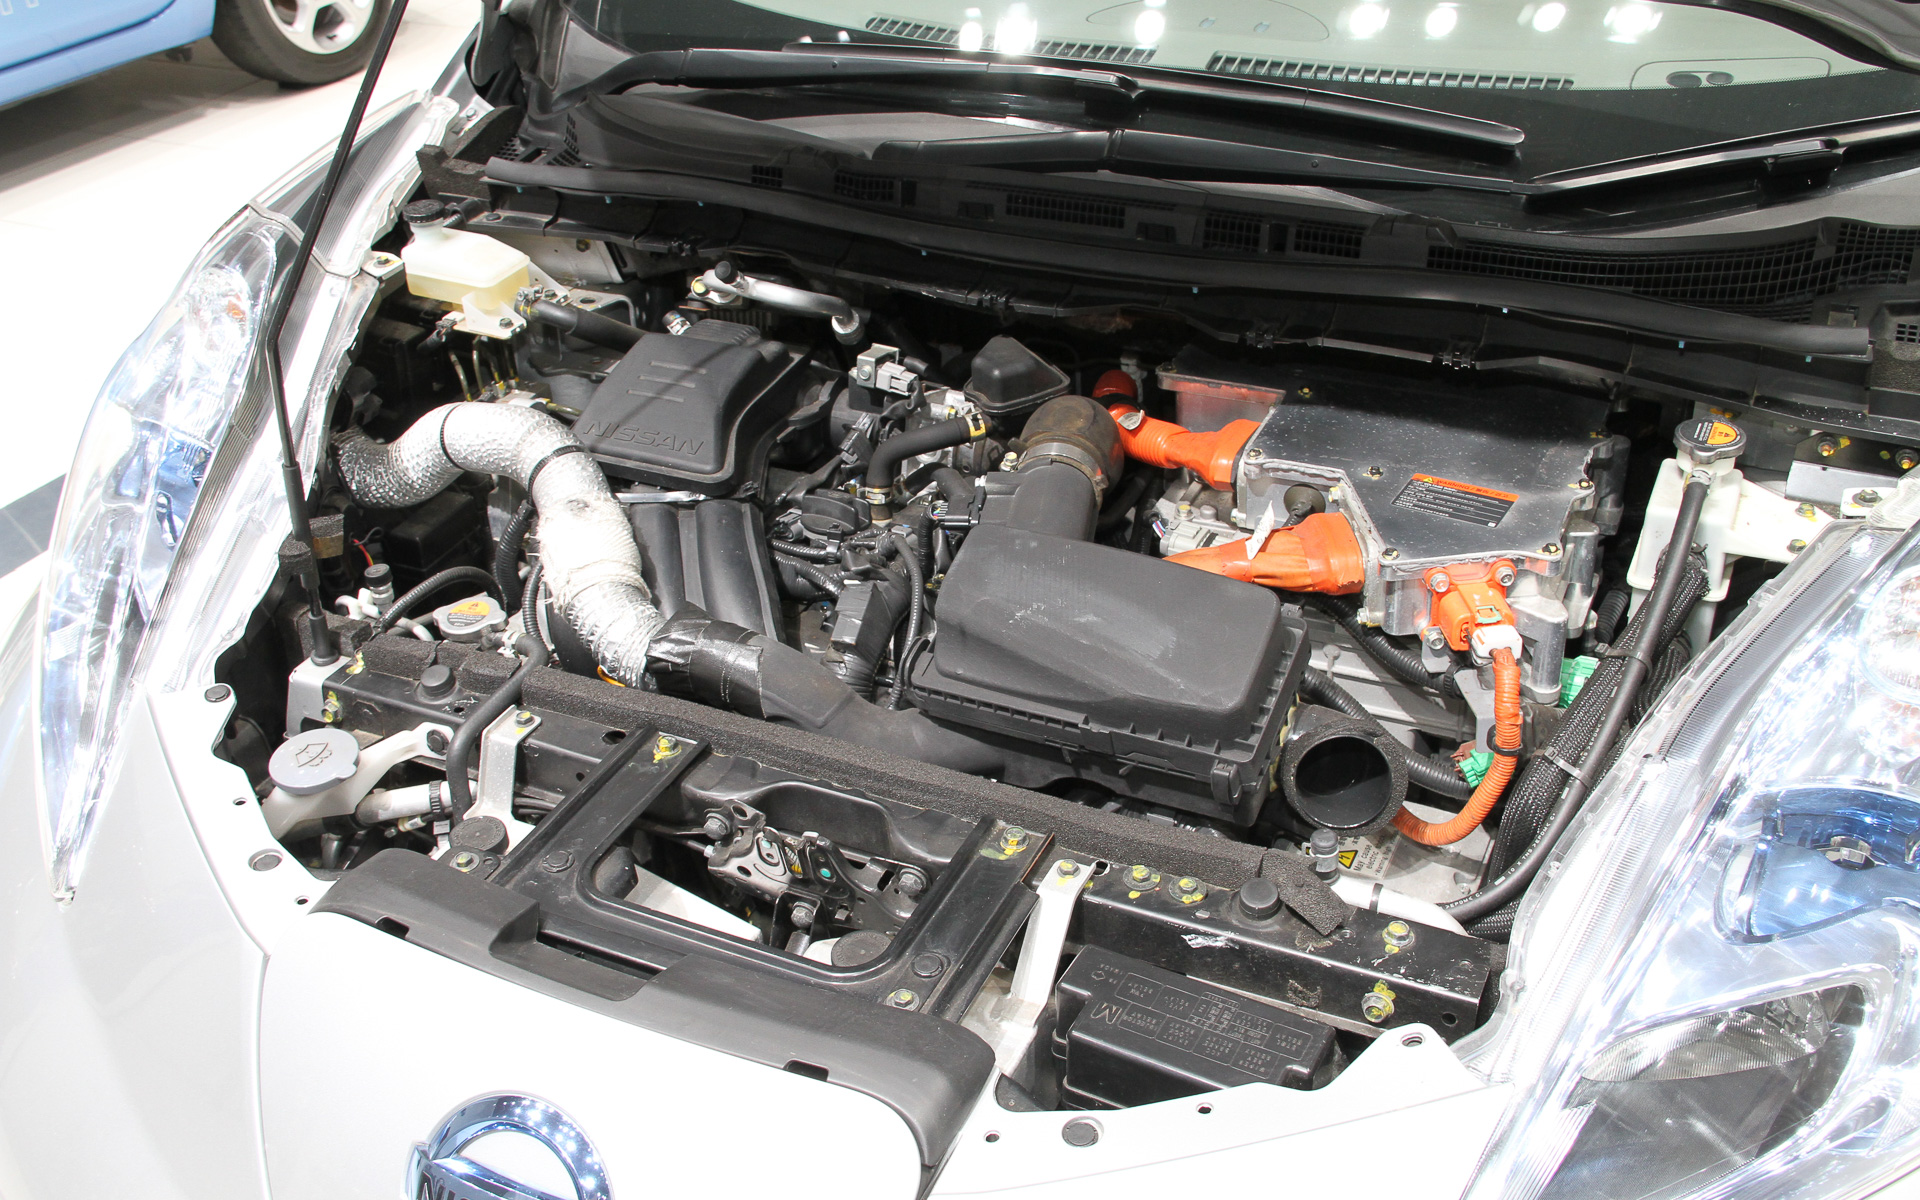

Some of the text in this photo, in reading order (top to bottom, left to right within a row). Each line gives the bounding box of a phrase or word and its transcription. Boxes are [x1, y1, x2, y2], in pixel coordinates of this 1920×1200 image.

[583, 421, 704, 456] NISSAN
[1437, 480, 1469, 490] WARNING
[1090, 1000, 1122, 1025] M
